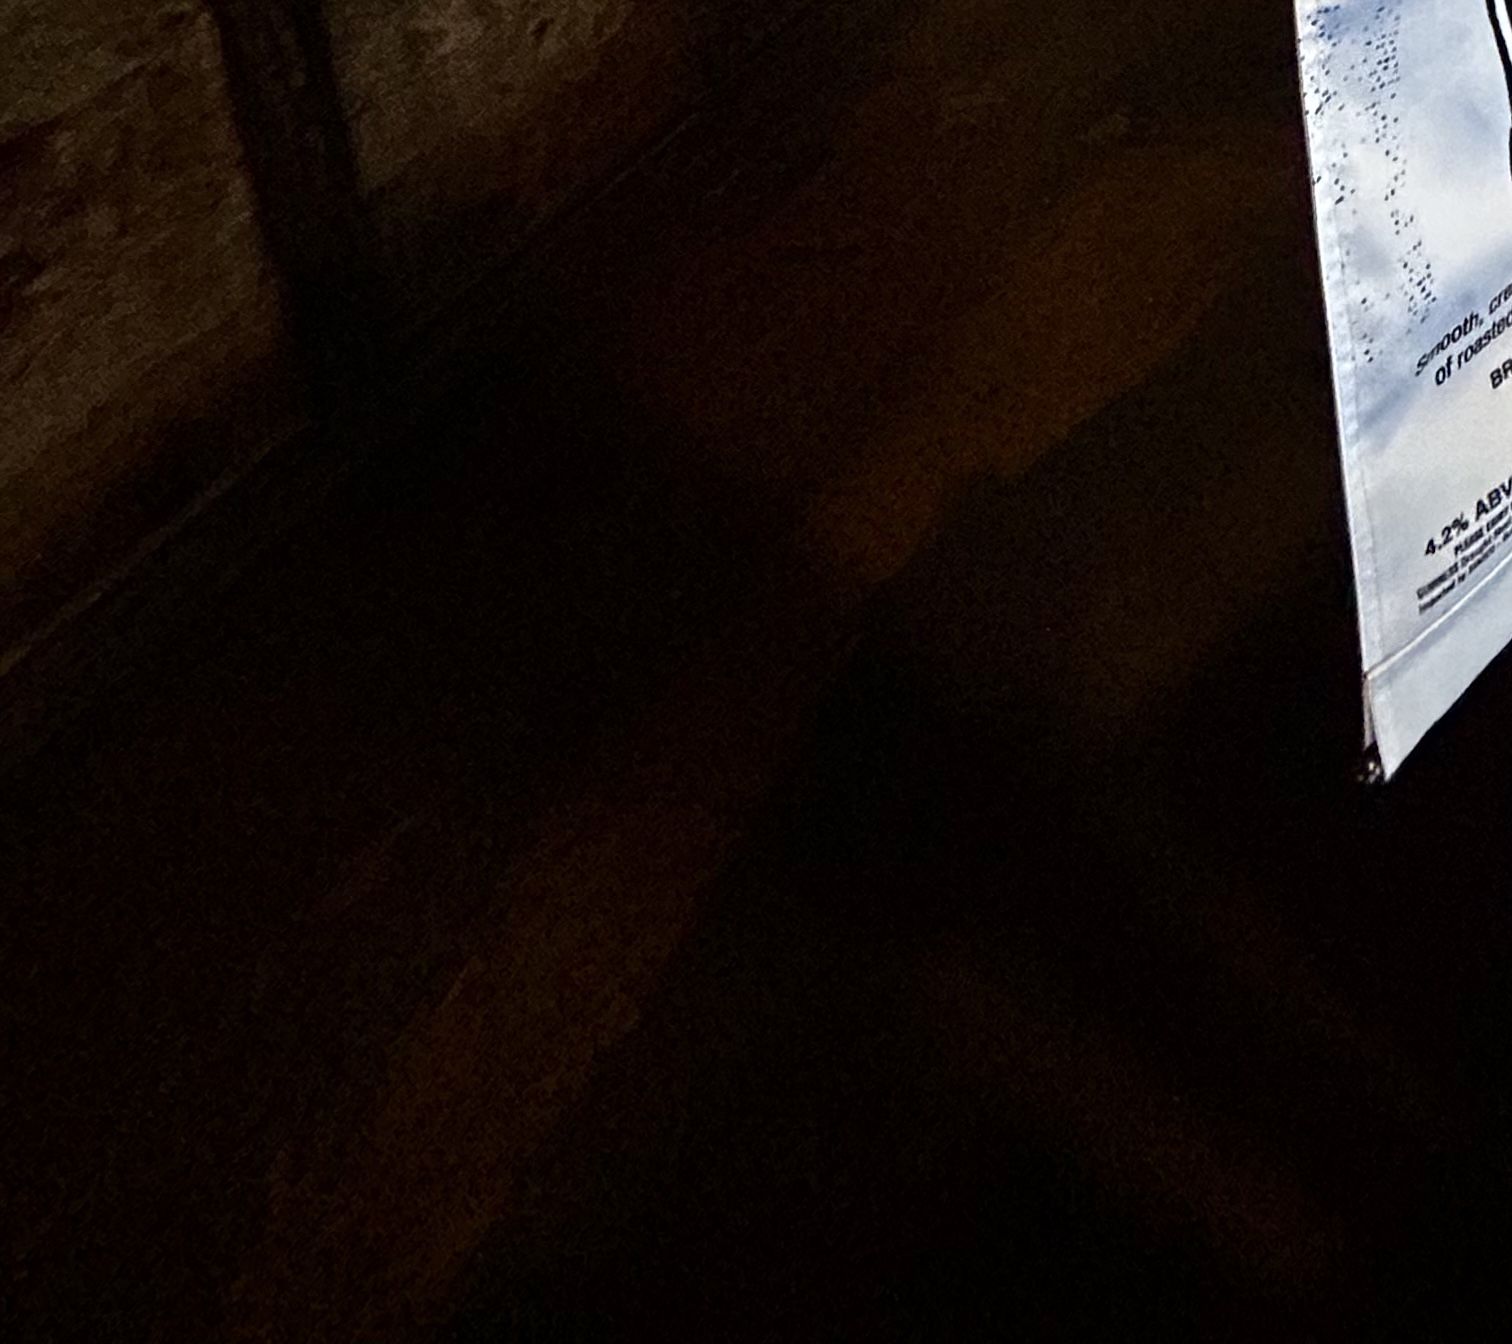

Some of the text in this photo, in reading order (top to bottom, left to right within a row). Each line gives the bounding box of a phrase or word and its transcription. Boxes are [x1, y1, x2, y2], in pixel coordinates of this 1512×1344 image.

[1415, 309, 1484, 377] Smooth,
[1434, 355, 1453, 387] of
[1425, 511, 1470, 557] 4.2%
